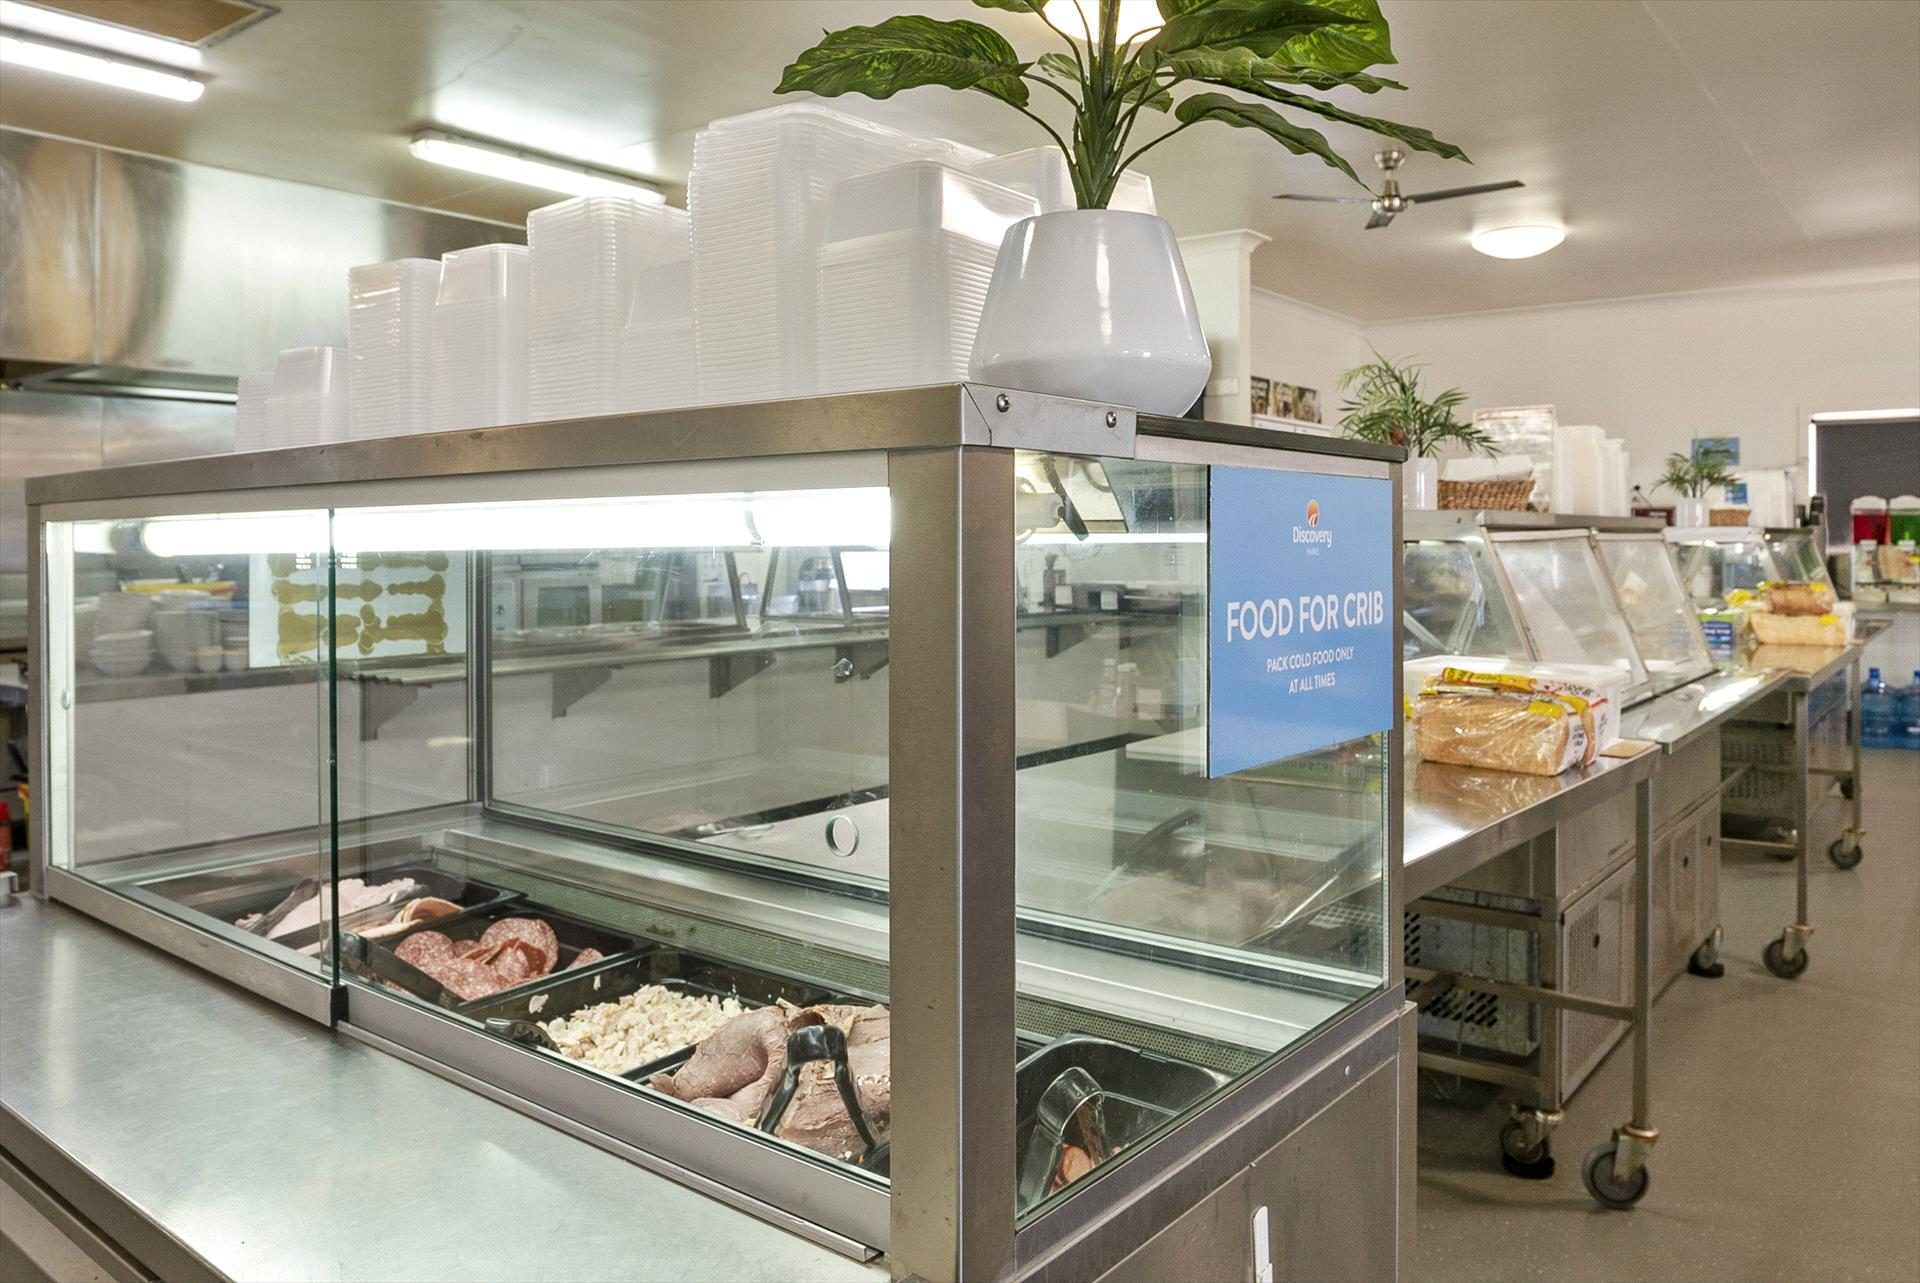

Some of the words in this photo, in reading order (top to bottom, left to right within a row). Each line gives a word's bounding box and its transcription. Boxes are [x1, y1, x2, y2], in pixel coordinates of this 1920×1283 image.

[1293, 526, 1332, 548] Discovery
[1227, 598, 1293, 642] FOOD
[1299, 594, 1339, 633] FOR
[1343, 591, 1384, 627] CRIB
[1267, 657, 1288, 673] PACK
[1289, 653, 1312, 670] COLD
[1312, 649, 1334, 665] FOOD
[1335, 646, 1354, 662] ONLY
[1288, 679, 1299, 694] AT
[1299, 676, 1313, 692] ALL
[1314, 672, 1336, 688] TIMES
